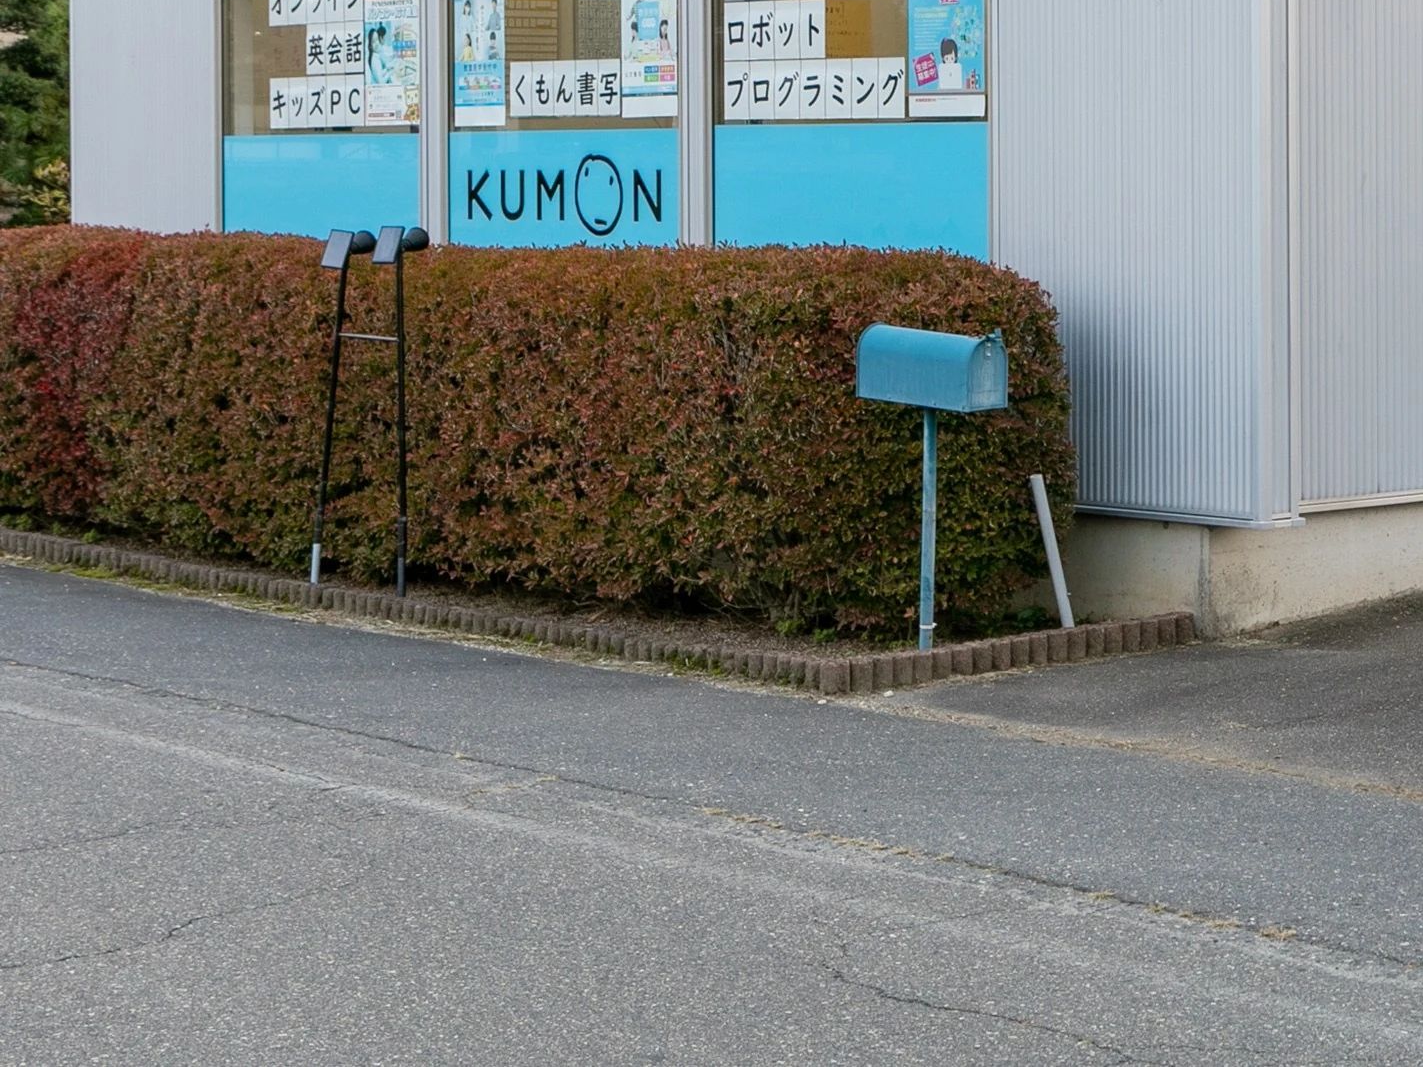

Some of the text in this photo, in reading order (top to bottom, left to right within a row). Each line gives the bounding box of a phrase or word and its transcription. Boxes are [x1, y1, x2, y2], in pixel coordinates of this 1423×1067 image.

[728, 11, 820, 48] ロボット
[308, 33, 362, 65] 英会話
[272, 86, 361, 119] キッズPC
[515, 71, 618, 105] くもん書写
[727, 69, 904, 107] プログラミング
[467, 154, 662, 236] KUMON
